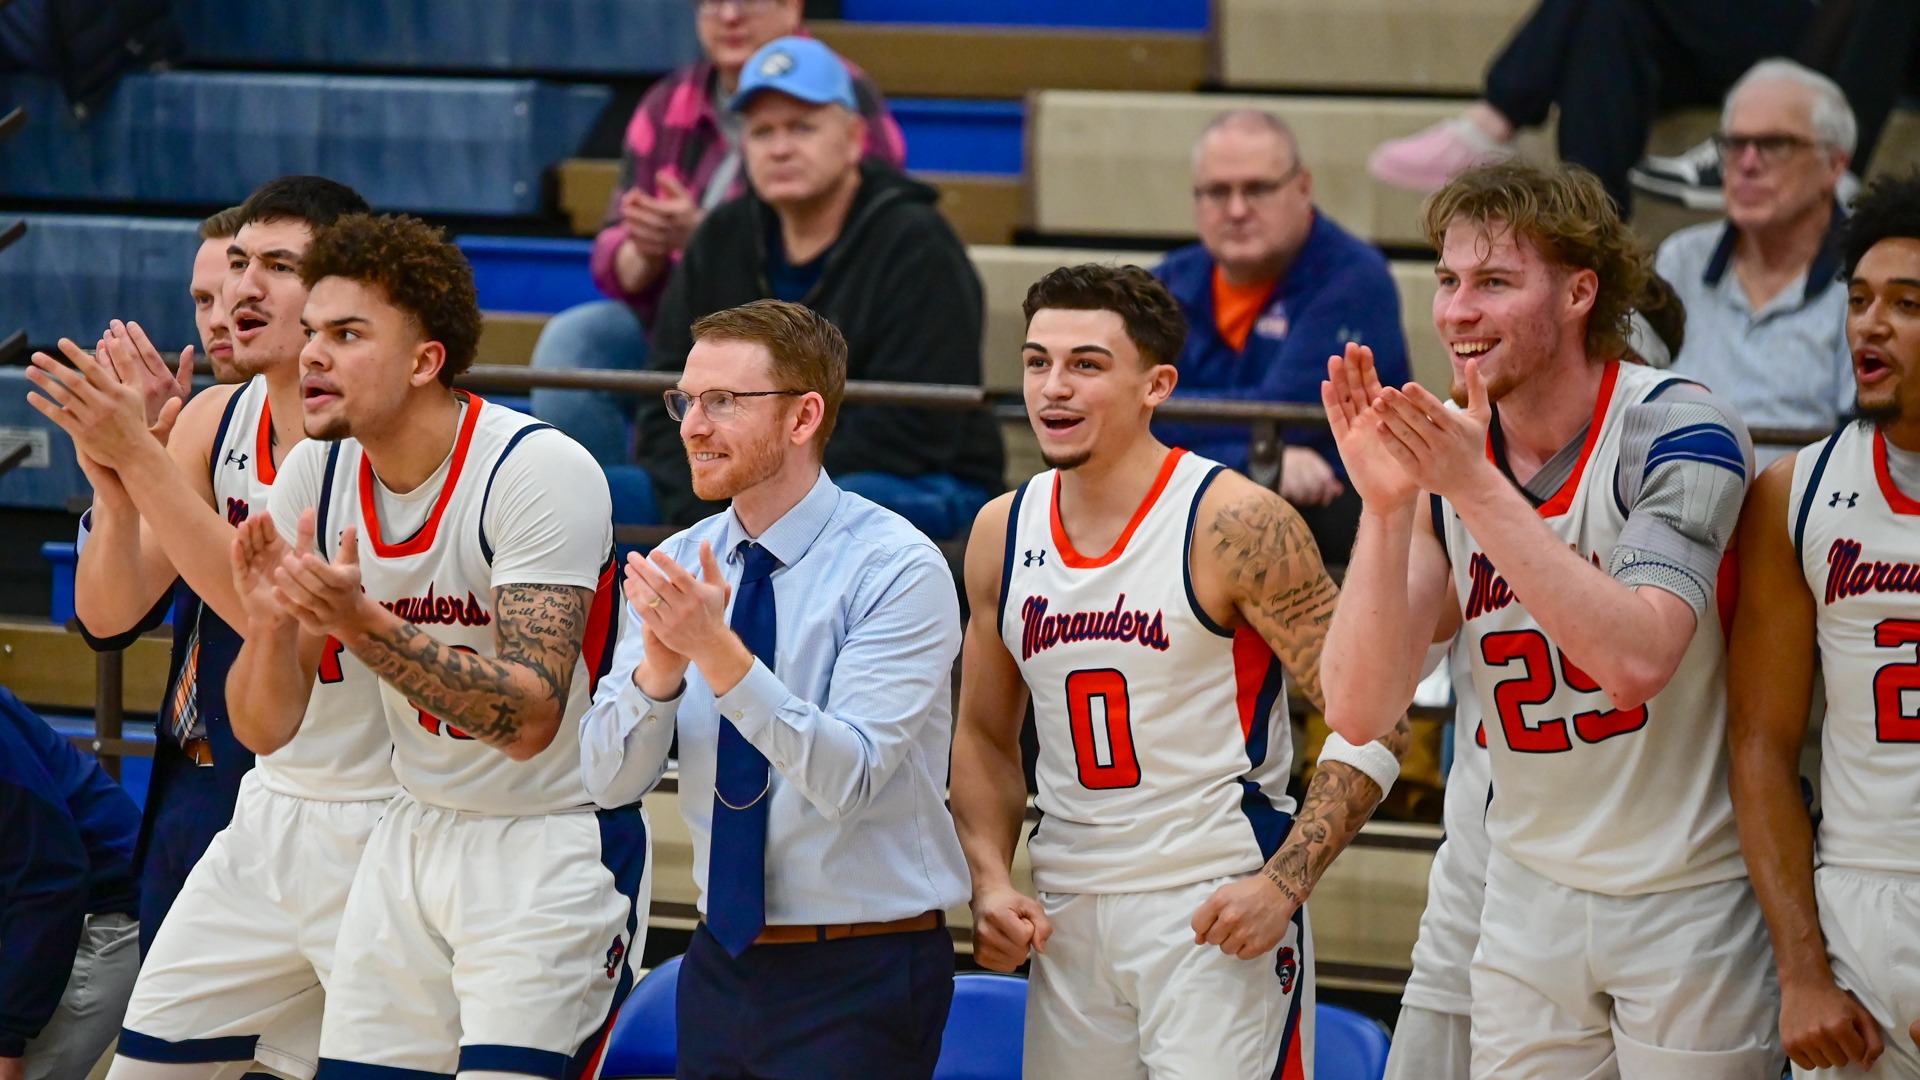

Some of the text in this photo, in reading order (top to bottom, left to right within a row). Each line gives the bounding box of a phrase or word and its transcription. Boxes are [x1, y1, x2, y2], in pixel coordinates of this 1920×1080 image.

[513, 594, 534, 603] the
[1824, 538, 1920, 606] Marau
[379, 580, 491, 627] auders
[507, 608, 574, 630] will be my
[1021, 593, 1170, 662] Marauders
[1065, 668, 1141, 790] 0
